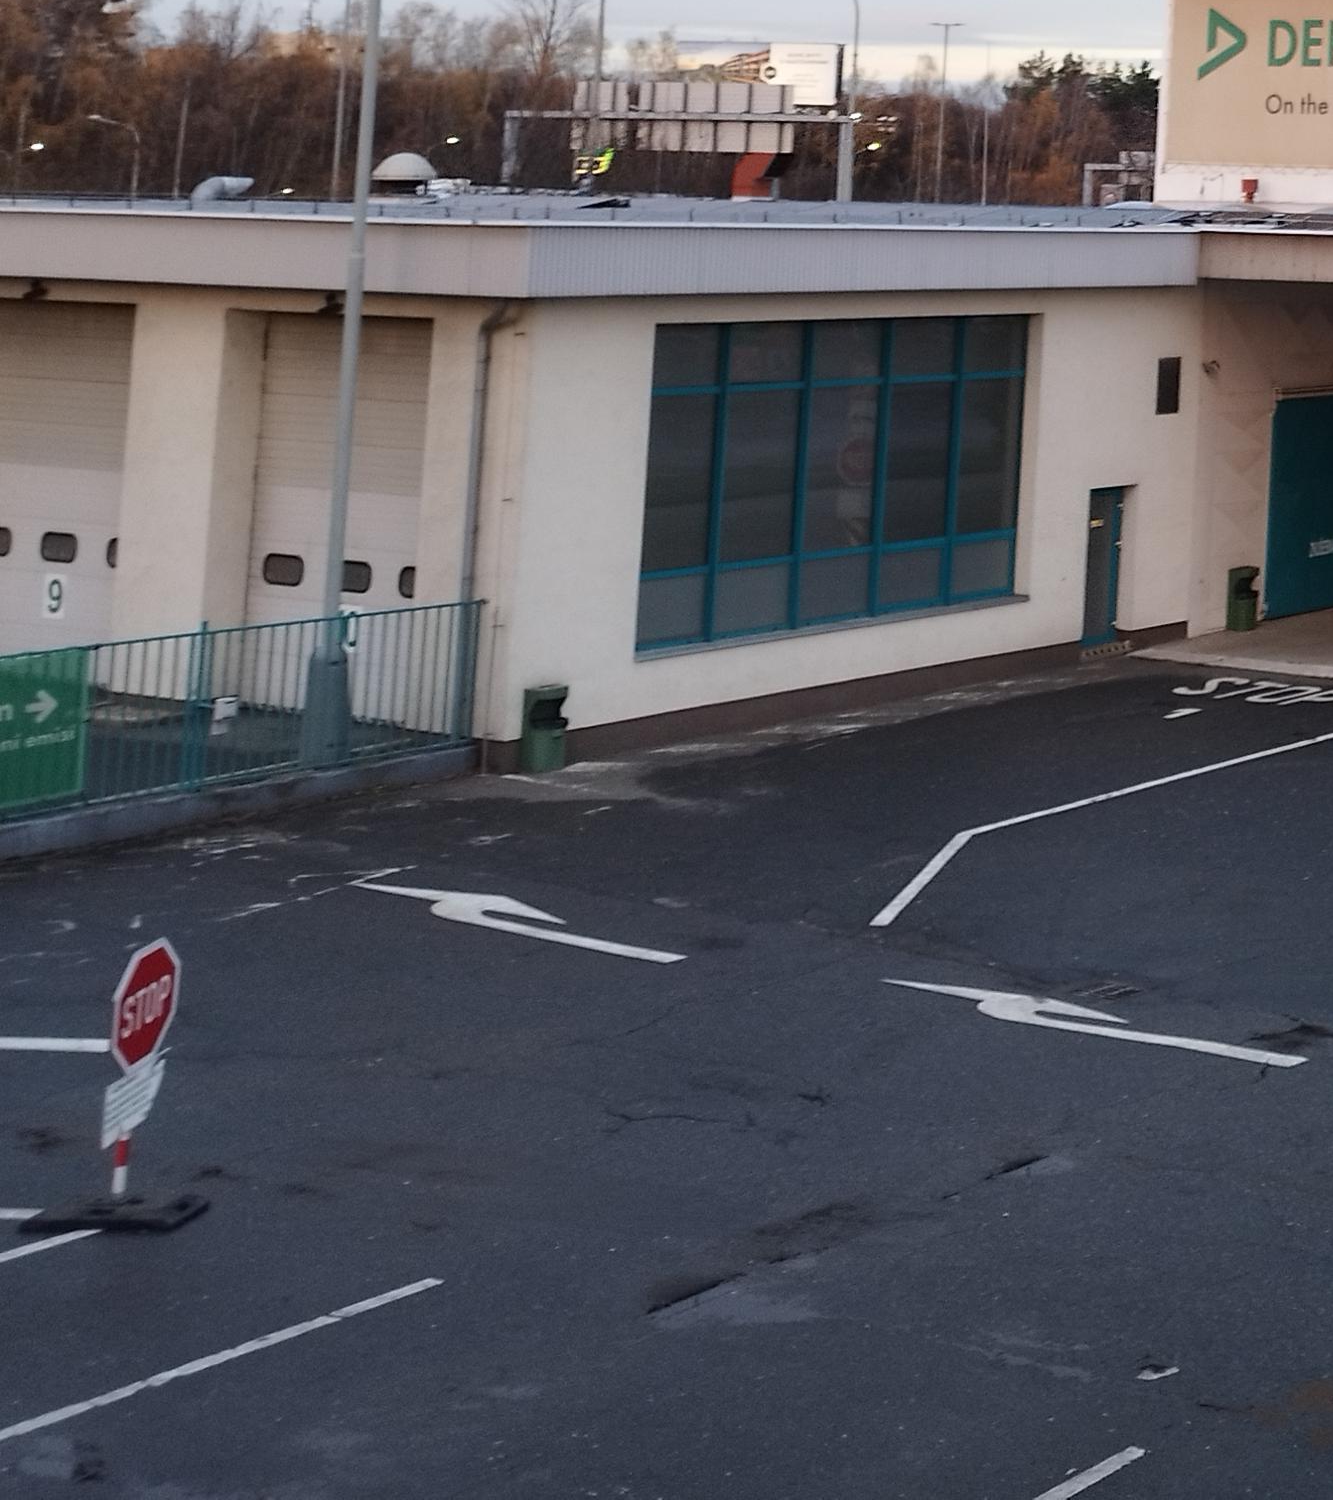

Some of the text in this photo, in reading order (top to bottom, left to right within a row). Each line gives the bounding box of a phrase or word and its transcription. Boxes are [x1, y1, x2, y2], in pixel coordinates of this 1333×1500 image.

[1265, 94, 1294, 114] On
[1300, 93, 1328, 115] the
[48, 578, 63, 613] 9
[1163, 708, 1203, 719] 1
[120, 974, 172, 1040] STOP
